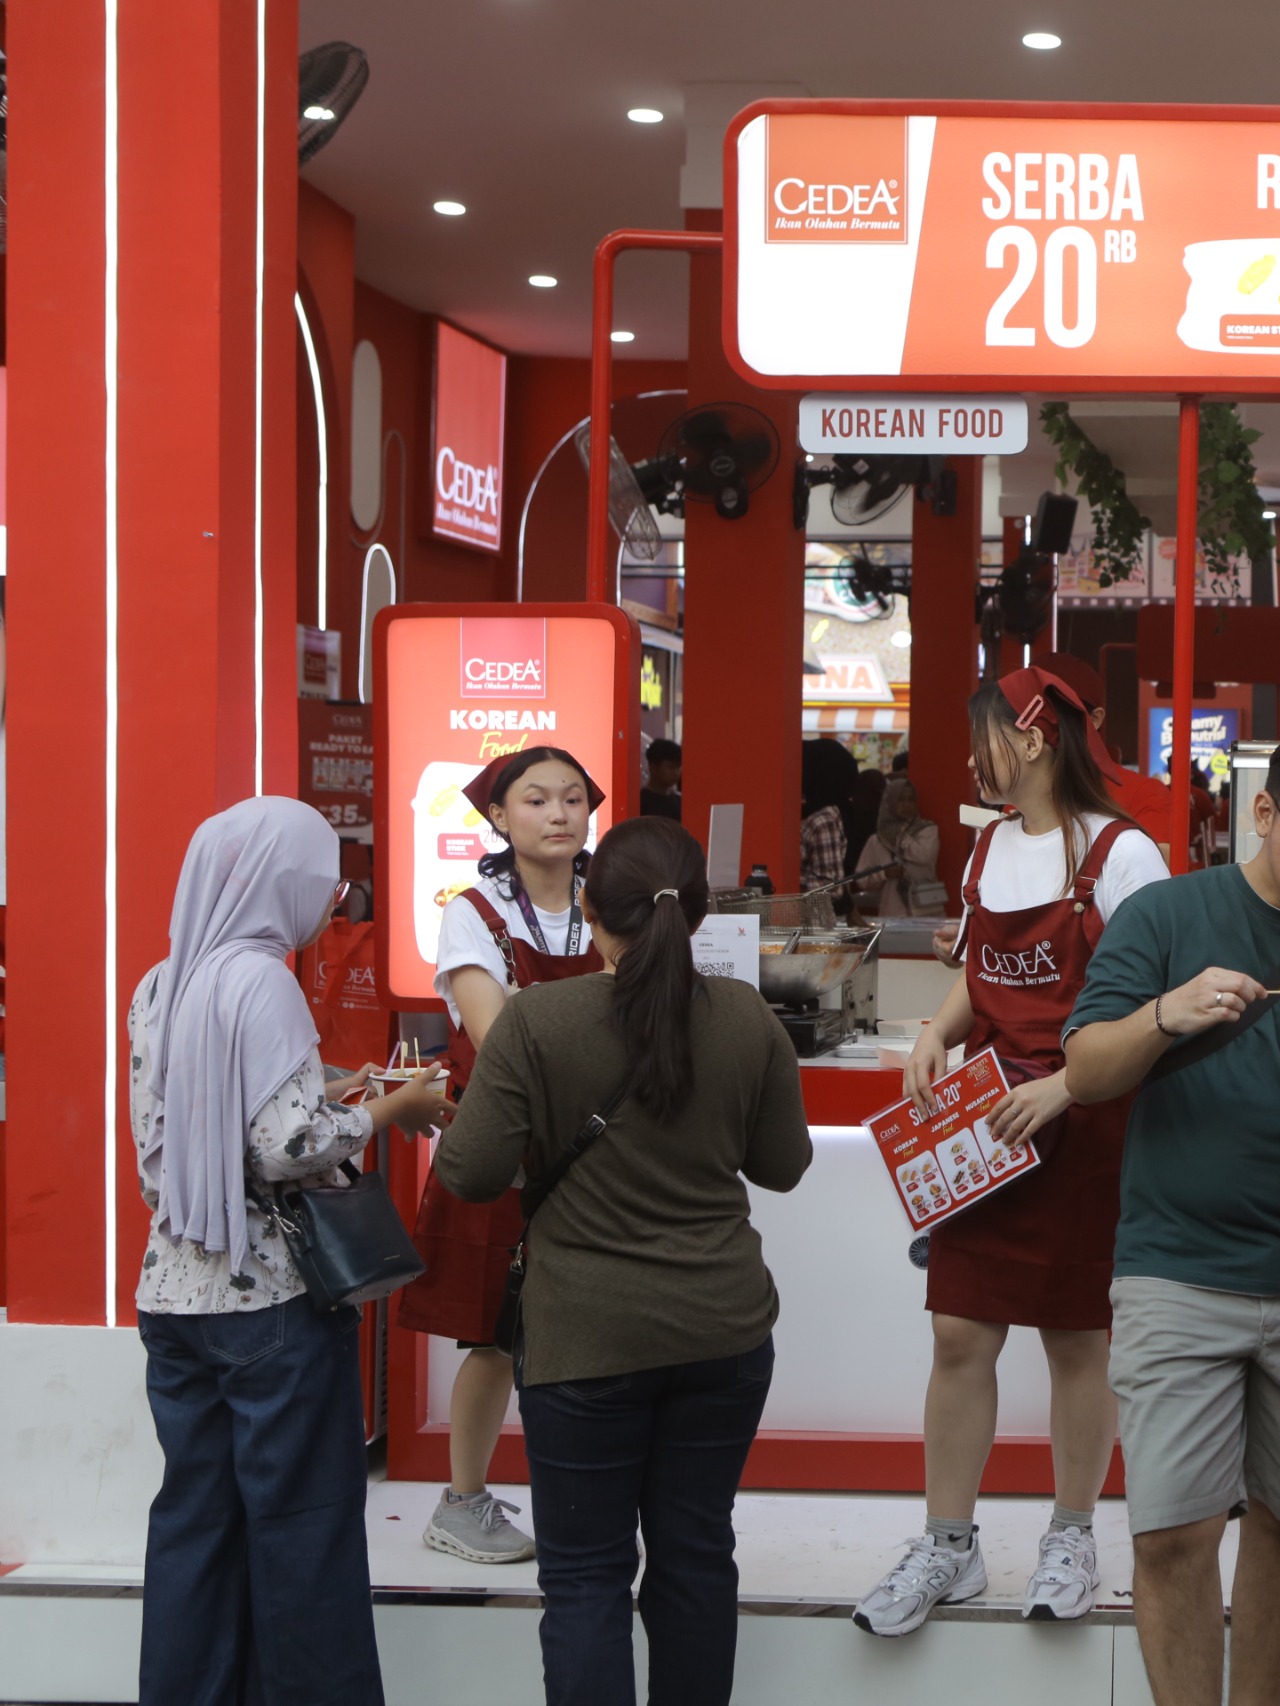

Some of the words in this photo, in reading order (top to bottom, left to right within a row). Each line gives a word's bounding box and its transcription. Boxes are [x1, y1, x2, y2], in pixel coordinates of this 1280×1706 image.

[774, 177, 900, 215] CEDEA
[982, 151, 1145, 221] SERBA
[775, 217, 802, 229] Ikan
[805, 217, 847, 229] Olahan
[850, 218, 900, 230] Bermutu
[985, 226, 1097, 348] 20
[1104, 230, 1138, 263] RB
[1227, 325, 1270, 335] KOREAN
[821, 409, 926, 439] KOREAN
[938, 408, 1004, 438] FOOD
[437, 446, 498, 517] CEDEA
[465, 657, 541, 681] CEDEA
[450, 709, 557, 731] KOREAN
[310, 741, 345, 753] READY
[328, 734, 363, 745] PAKET
[479, 731, 529, 759] Food
[982, 944, 1056, 976] CEDEA
[943, 1084, 961, 1107] 20
[965, 1087, 1000, 1112] NUSANTARA
[931, 1112, 960, 1133] JAPANESE
[893, 1136, 918, 1155] KOREAN
